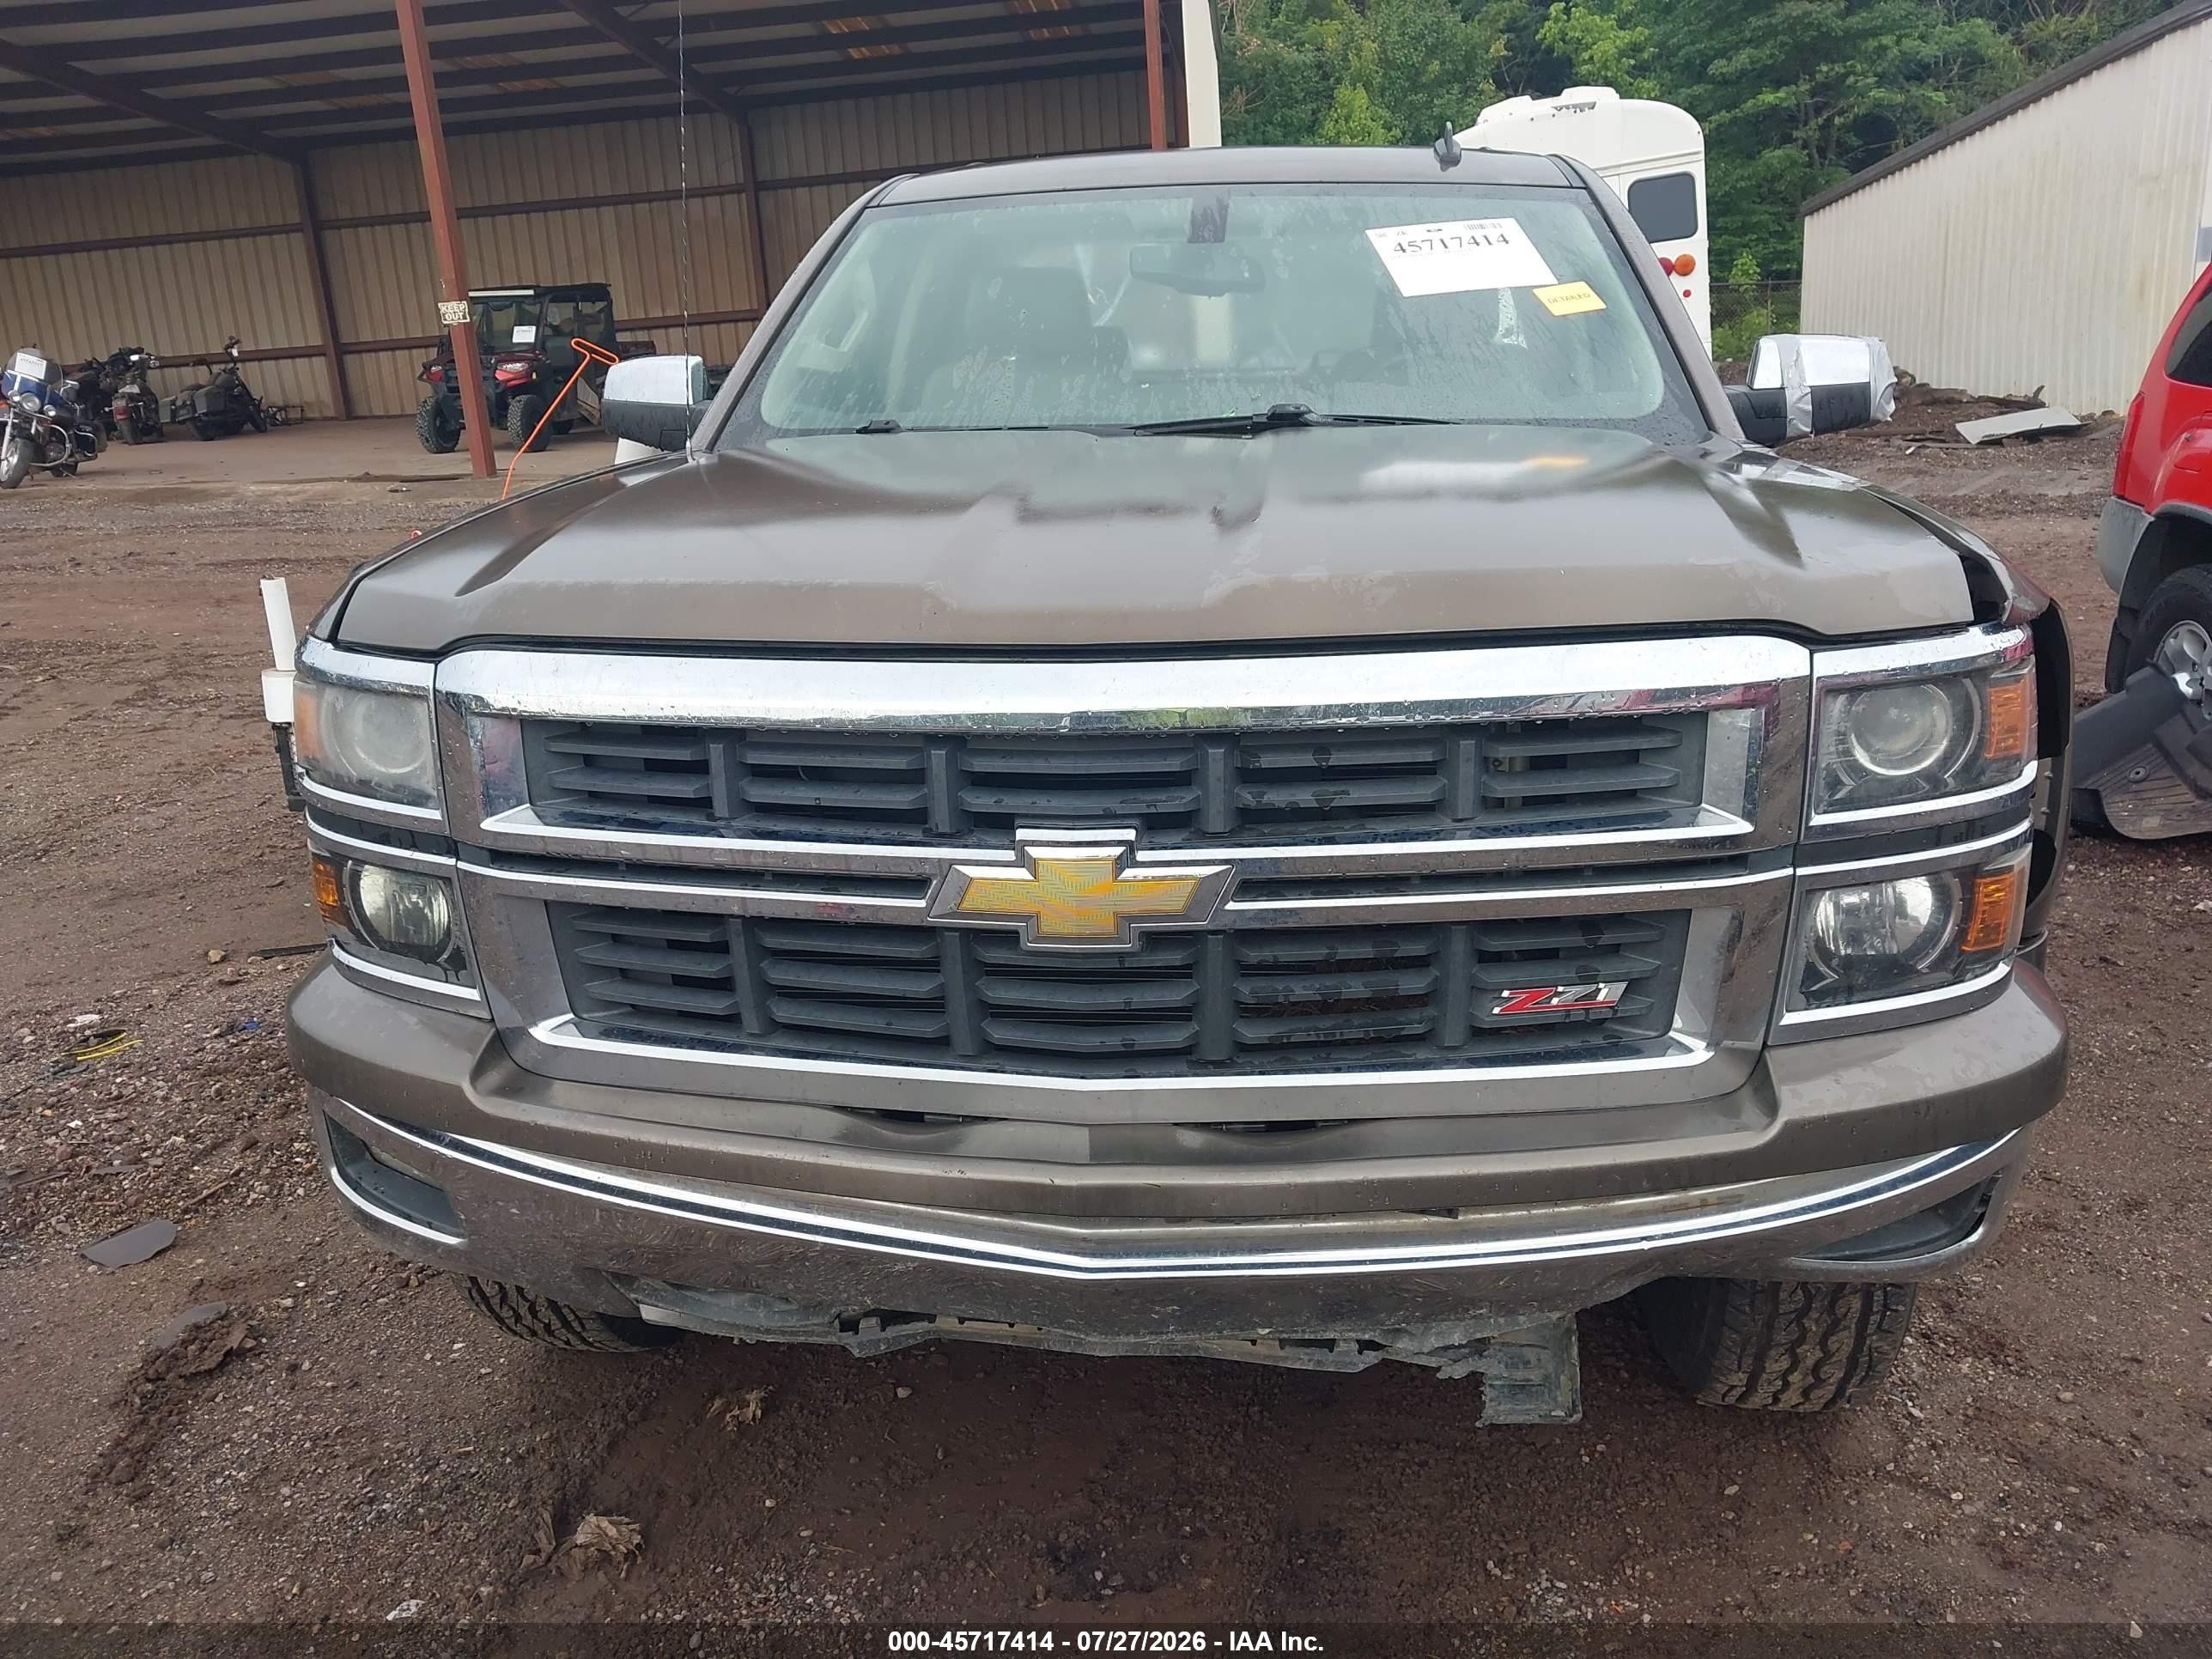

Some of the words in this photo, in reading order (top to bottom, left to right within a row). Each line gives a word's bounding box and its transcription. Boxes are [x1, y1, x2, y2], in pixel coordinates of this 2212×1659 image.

[1394, 233, 1510, 253] 45717414
[441, 303, 465, 314] KEEP
[445, 312, 465, 321] OUT
[1492, 981, 1629, 1015] Z71
